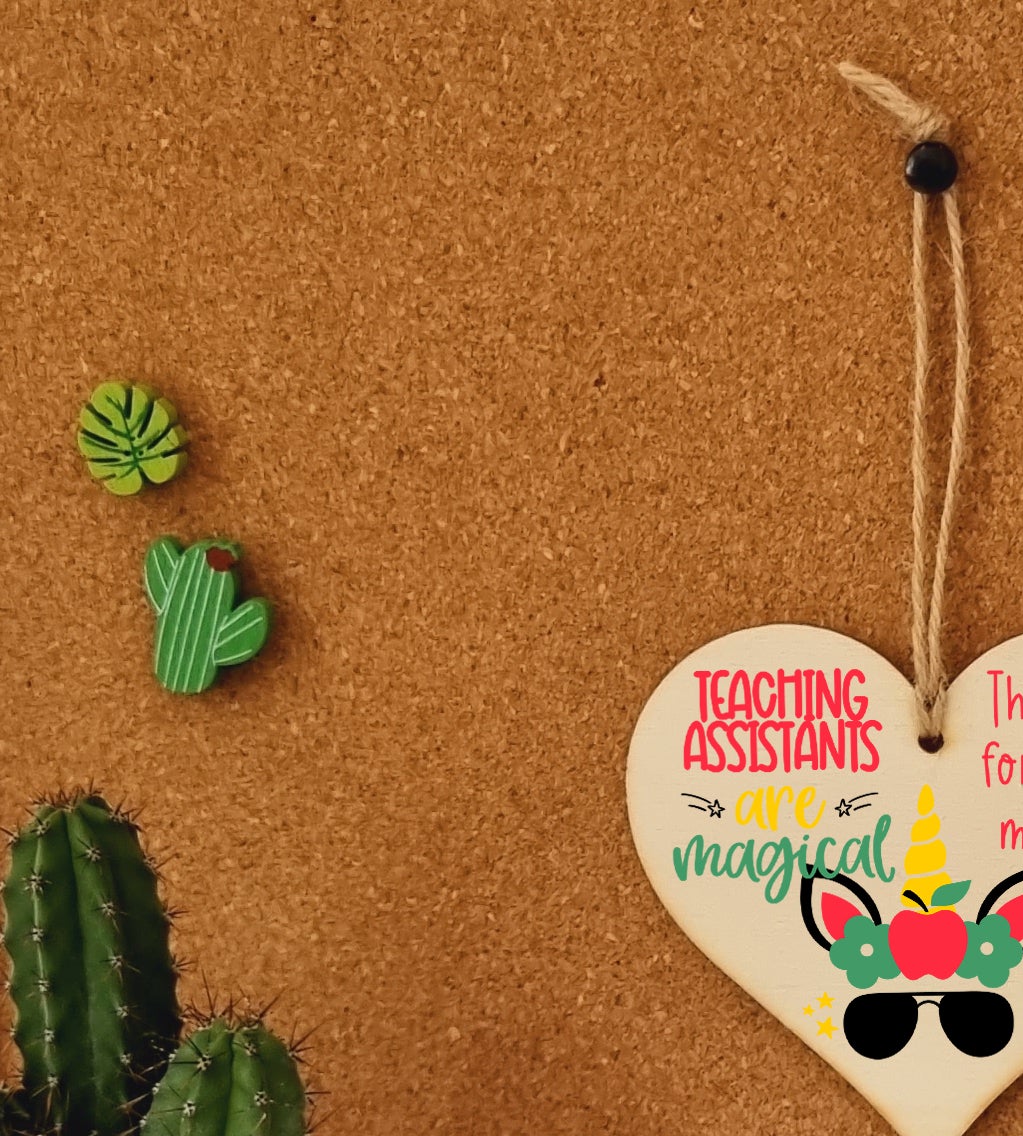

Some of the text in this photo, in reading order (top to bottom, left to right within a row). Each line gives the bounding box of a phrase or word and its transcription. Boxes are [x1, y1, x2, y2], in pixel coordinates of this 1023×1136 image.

[694, 668, 868, 720] TEACHING
[684, 720, 882, 773] ASSISTANTS
[735, 786, 826, 831] are
[673, 814, 896, 904] magical
